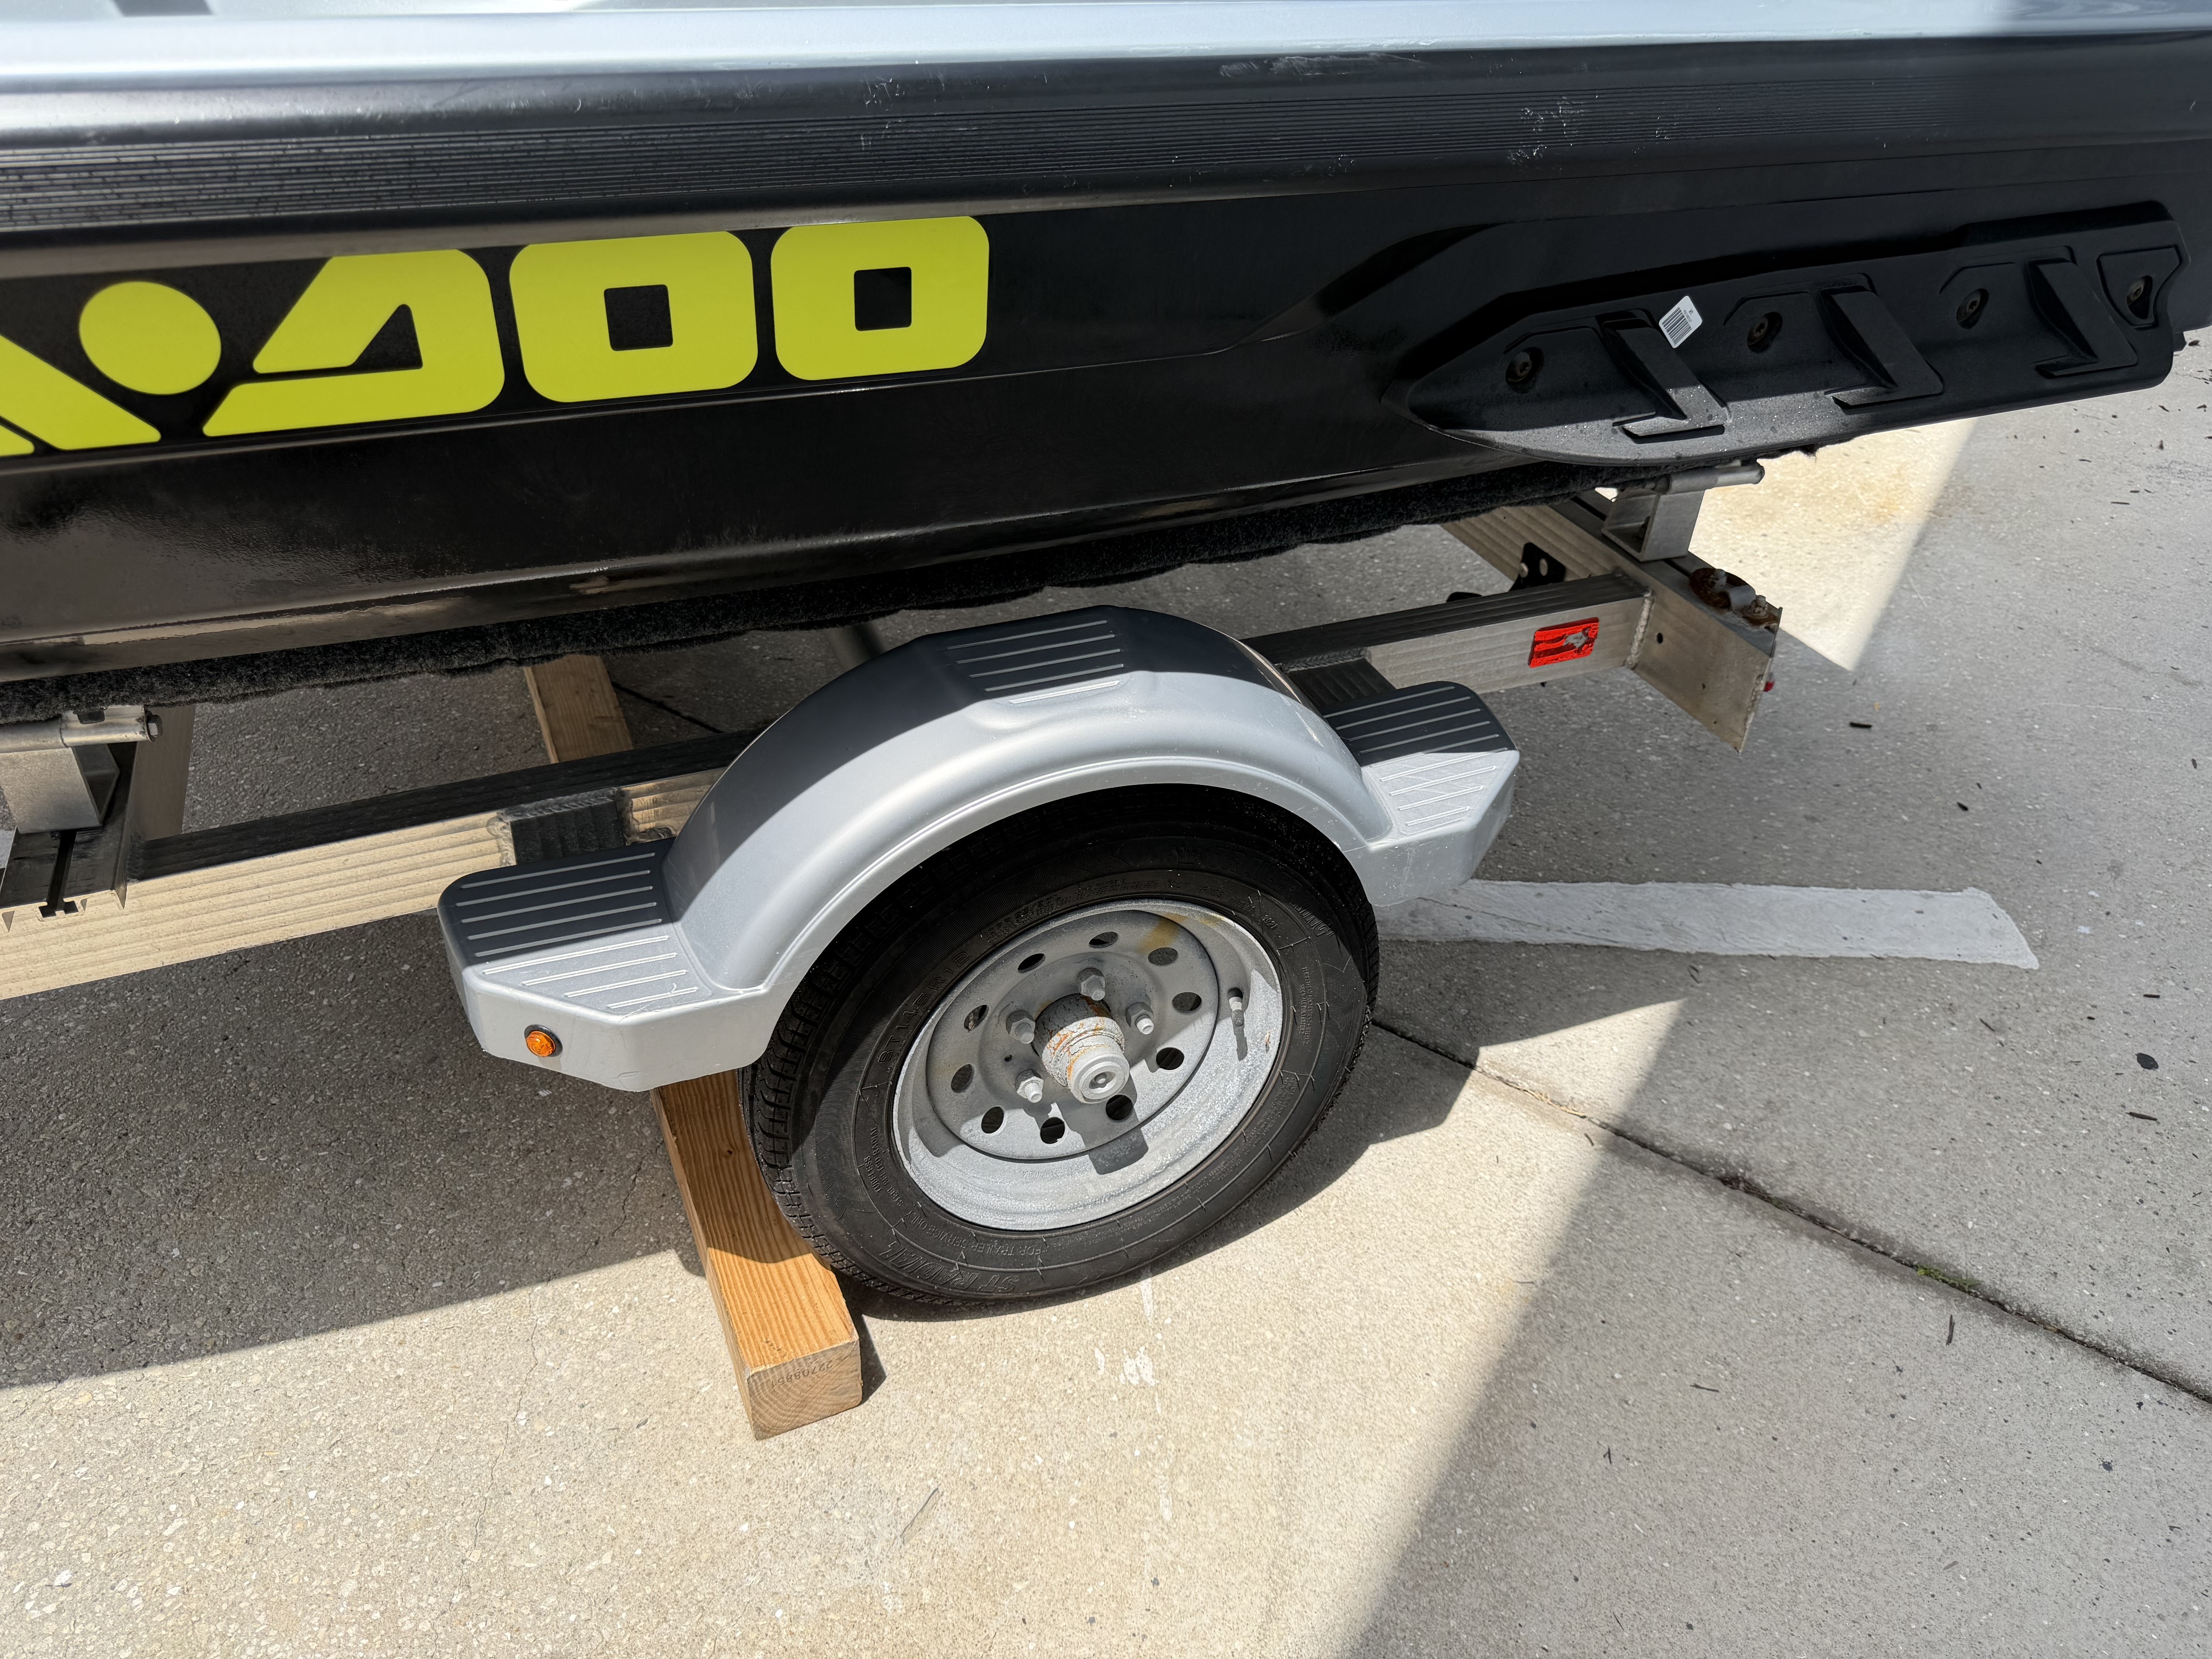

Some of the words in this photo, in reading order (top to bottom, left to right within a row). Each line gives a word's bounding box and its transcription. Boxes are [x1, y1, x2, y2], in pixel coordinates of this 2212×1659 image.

[870, 1126, 881, 1156] RADIAL
[863, 1155, 883, 1194] TUBELESS
[873, 1156, 890, 1186] BELTED
[902, 1209, 930, 1231] ONLY
[925, 1224, 971, 1249] SERVICE
[968, 1241, 1017, 1255] TRAILER
[1017, 1245, 1043, 1256] FOR
[878, 1240, 979, 1291] RADIAL
[976, 1274, 1021, 1293] ST
